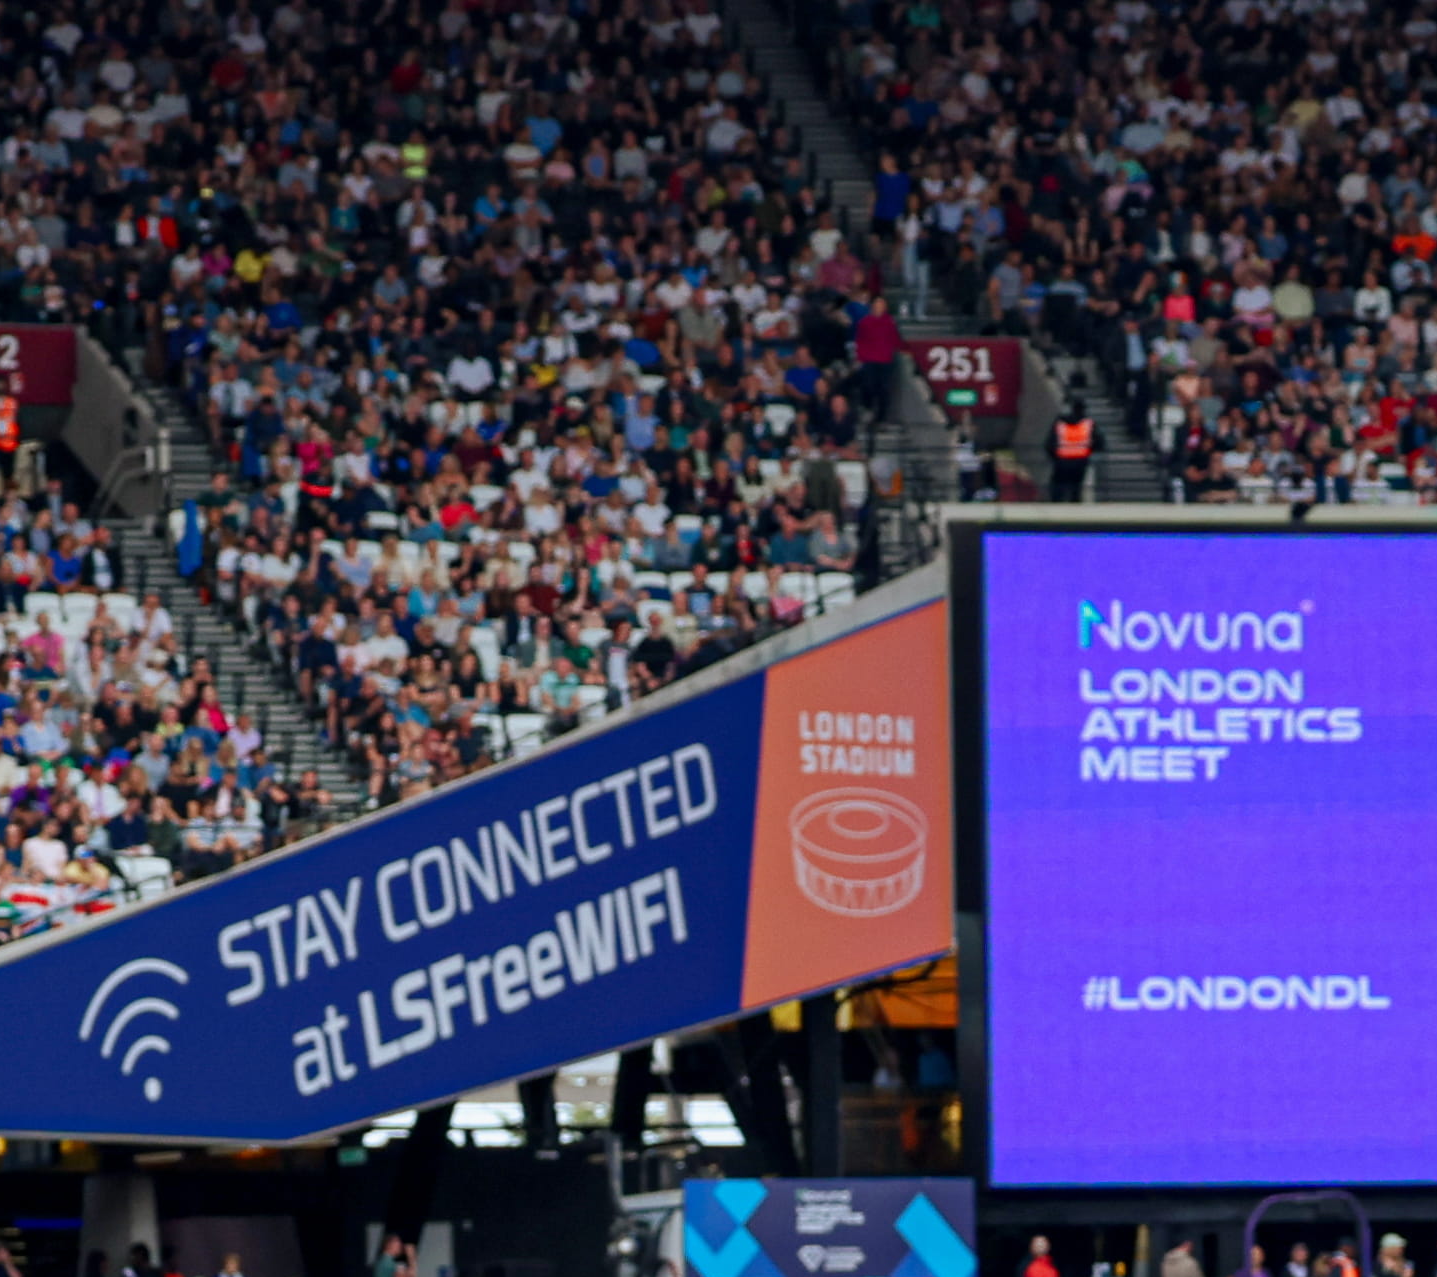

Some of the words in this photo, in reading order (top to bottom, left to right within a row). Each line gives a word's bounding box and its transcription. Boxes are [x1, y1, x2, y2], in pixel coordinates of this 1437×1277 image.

[927, 345, 994, 382] 251
[1077, 598, 1304, 652] Novuna
[1078, 666, 1305, 704] LONDON
[798, 710, 916, 745] LONDON
[1078, 706, 1364, 744] ATHLETICS
[799, 741, 917, 777] STADIUM
[1078, 745, 1232, 783] MEET
[217, 875, 363, 1008] STAY
[375, 742, 720, 944] CONNECTED
[291, 1004, 358, 1098] at
[358, 866, 689, 1071] LSFreeWIFI
[1081, 974, 1392, 1013] #LONDONDL
